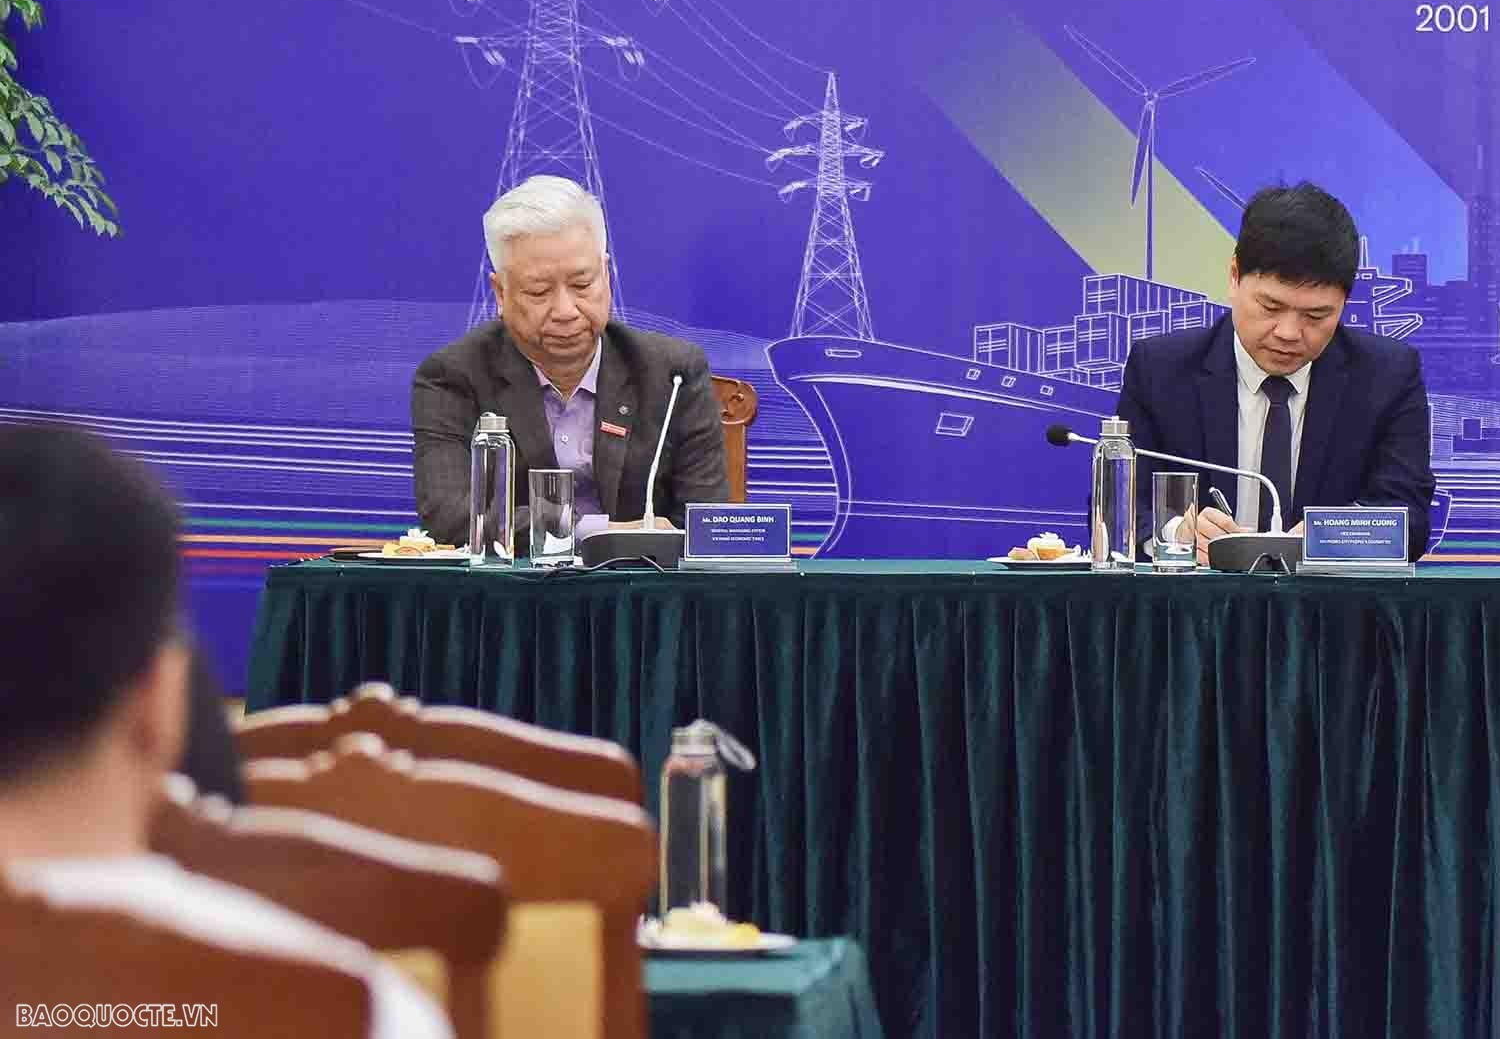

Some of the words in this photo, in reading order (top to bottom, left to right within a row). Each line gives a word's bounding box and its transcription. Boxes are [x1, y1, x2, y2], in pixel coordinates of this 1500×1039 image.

[1415, 4, 1489, 32] 2001
[729, 516, 756, 525] QUANG
[757, 516, 774, 524] BINH
